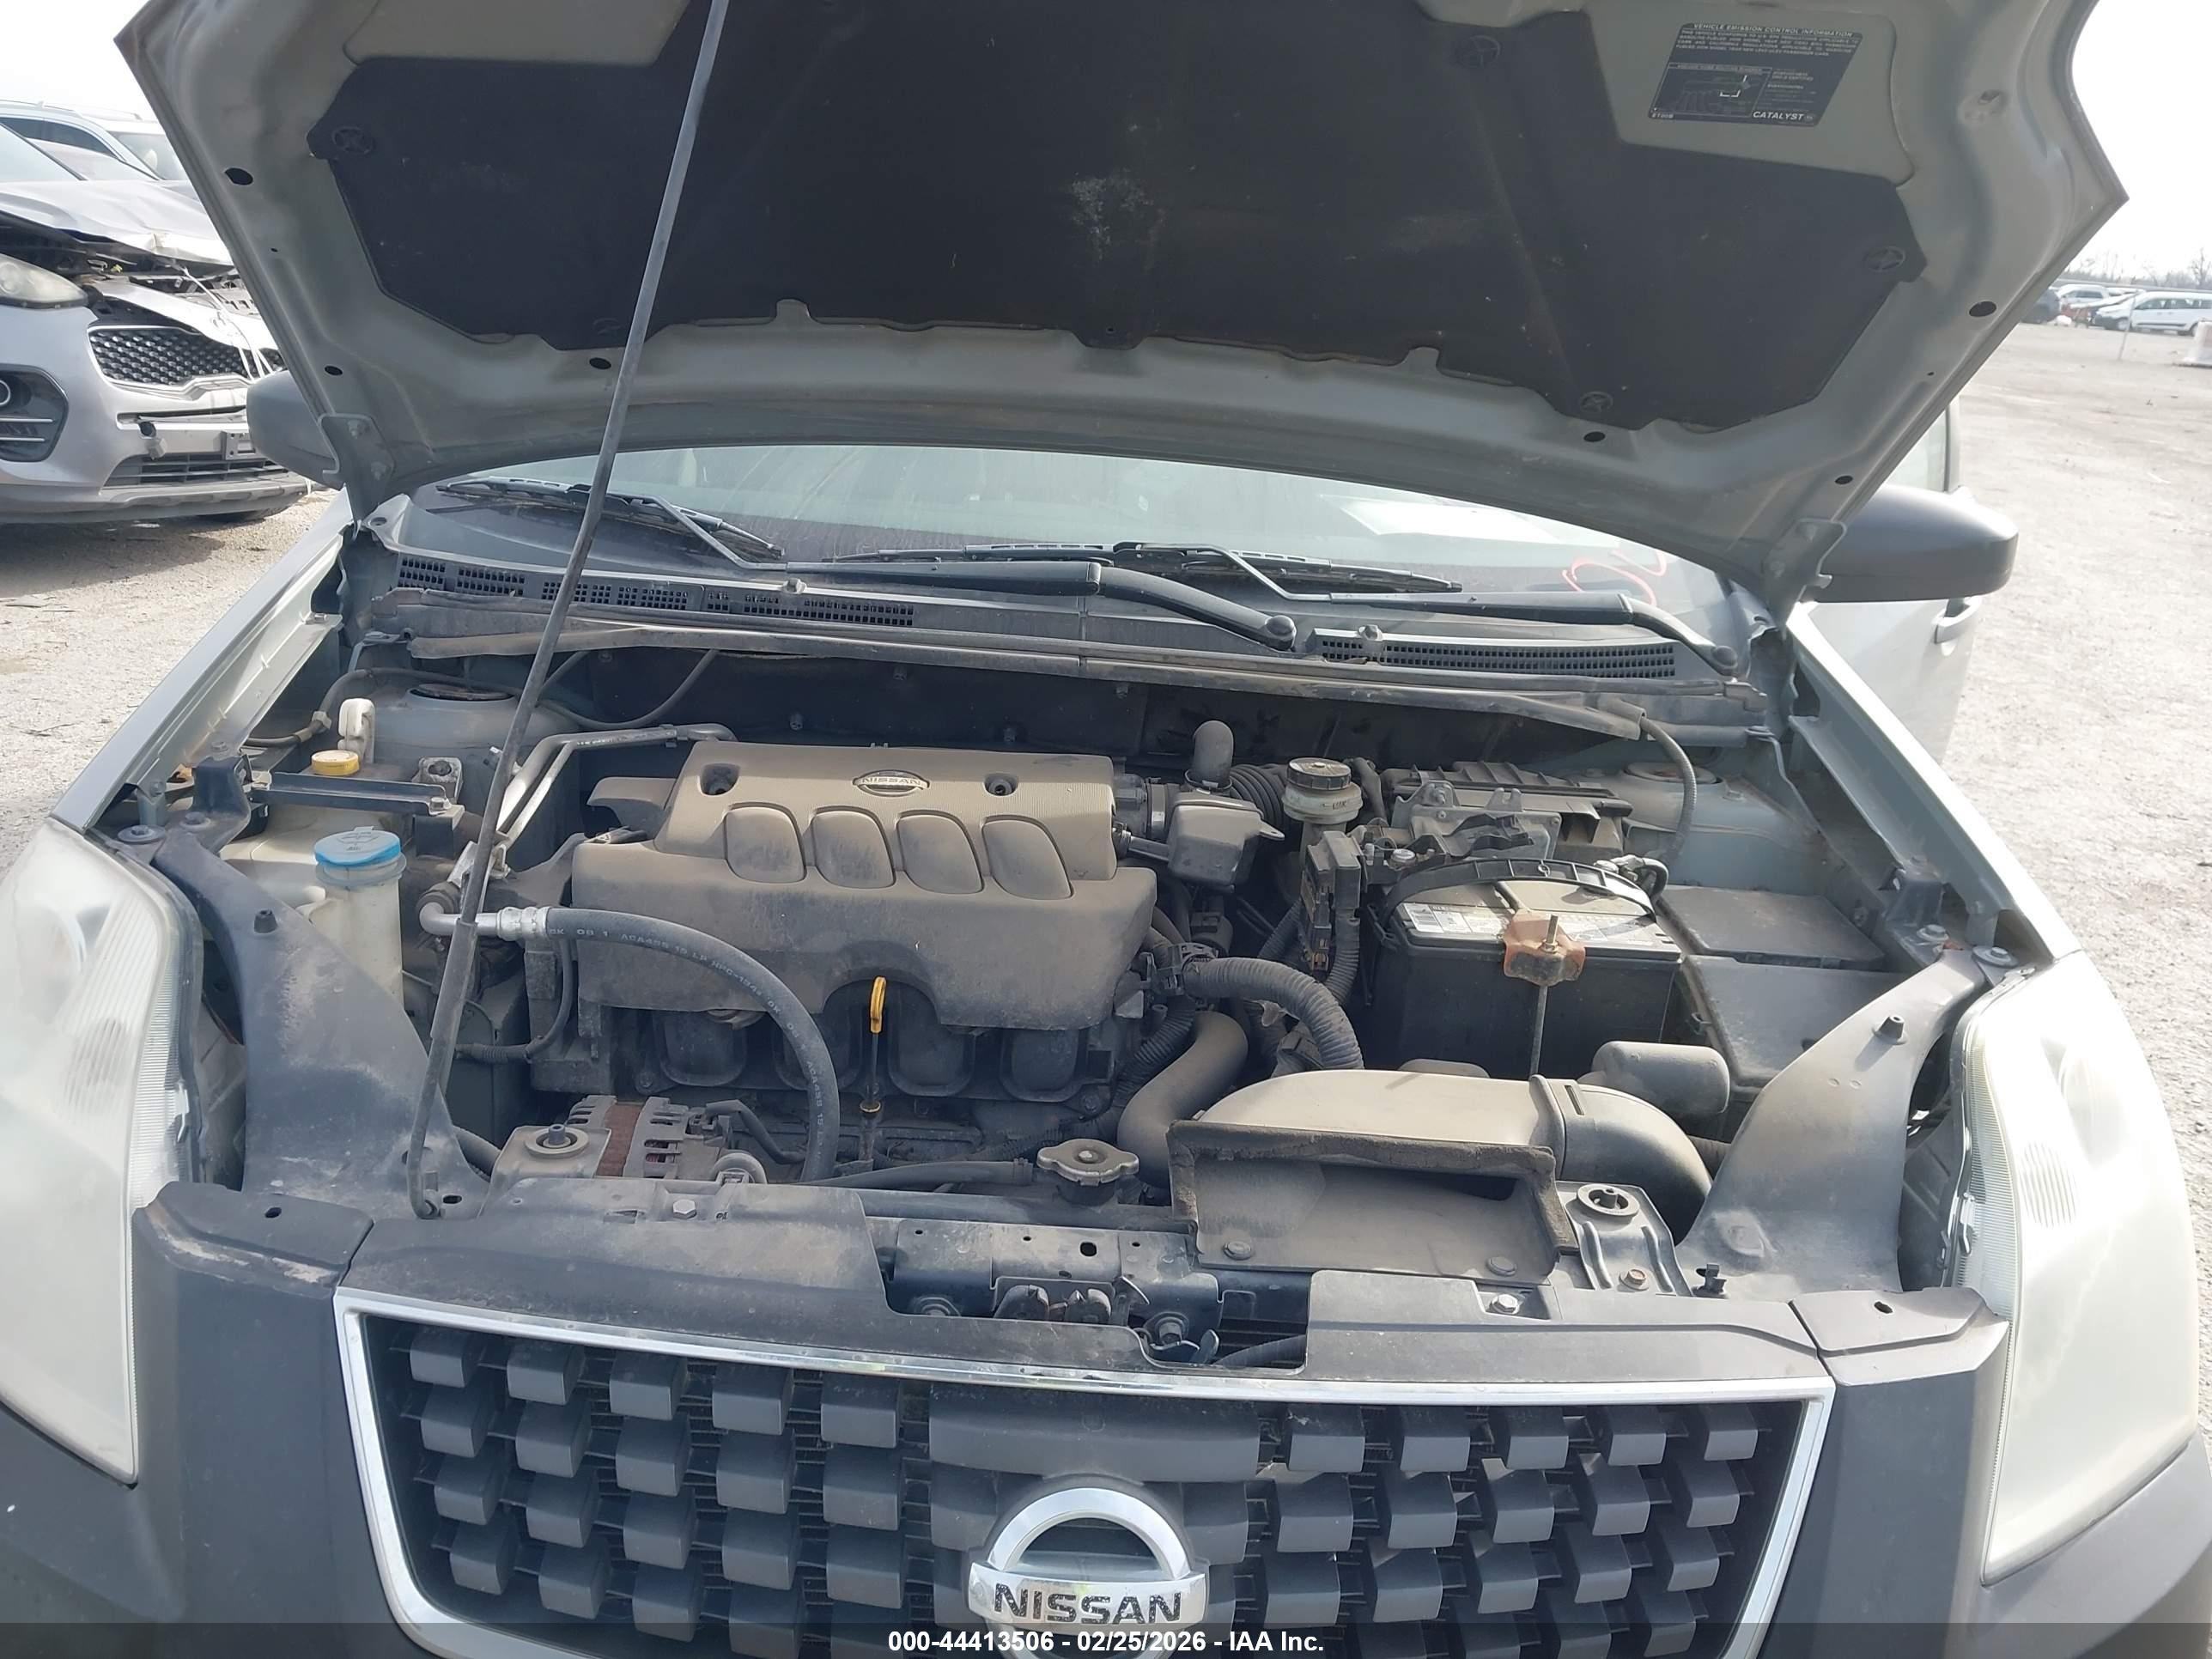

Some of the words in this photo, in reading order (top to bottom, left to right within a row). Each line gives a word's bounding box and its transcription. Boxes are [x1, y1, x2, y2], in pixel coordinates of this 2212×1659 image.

[1726, 24, 1763, 33] EMISSION
[1765, 26, 1800, 34] CONTROL
[1801, 28, 1853, 37] INFORMATION
[1753, 111, 1805, 121] CATALYST
[994, 1582, 1182, 1625] NISSAN
